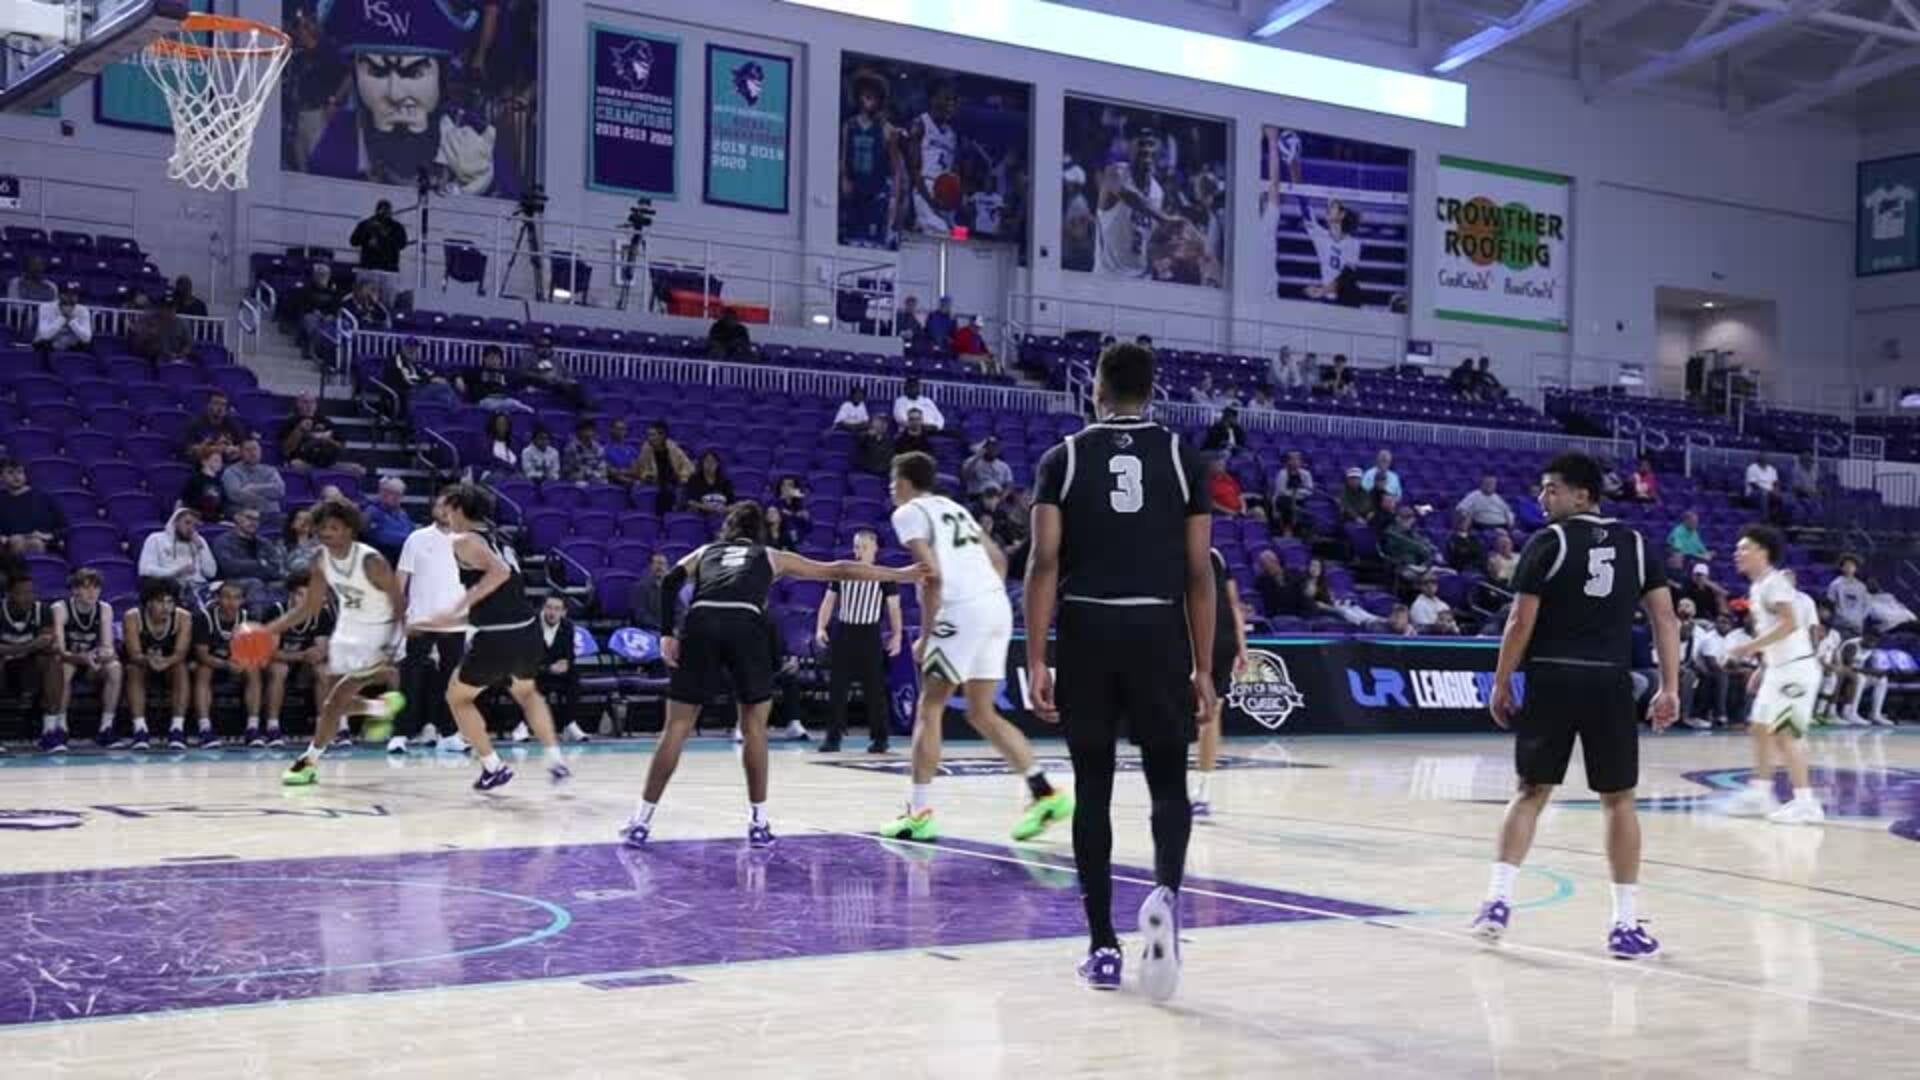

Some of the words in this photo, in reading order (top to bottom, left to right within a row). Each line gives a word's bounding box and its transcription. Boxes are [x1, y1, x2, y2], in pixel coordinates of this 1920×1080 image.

[1436, 196, 1565, 241] CROWTHER
[1445, 230, 1551, 268] ROOFING
[1109, 455, 1143, 513] 3
[1583, 546, 1617, 597] 5
